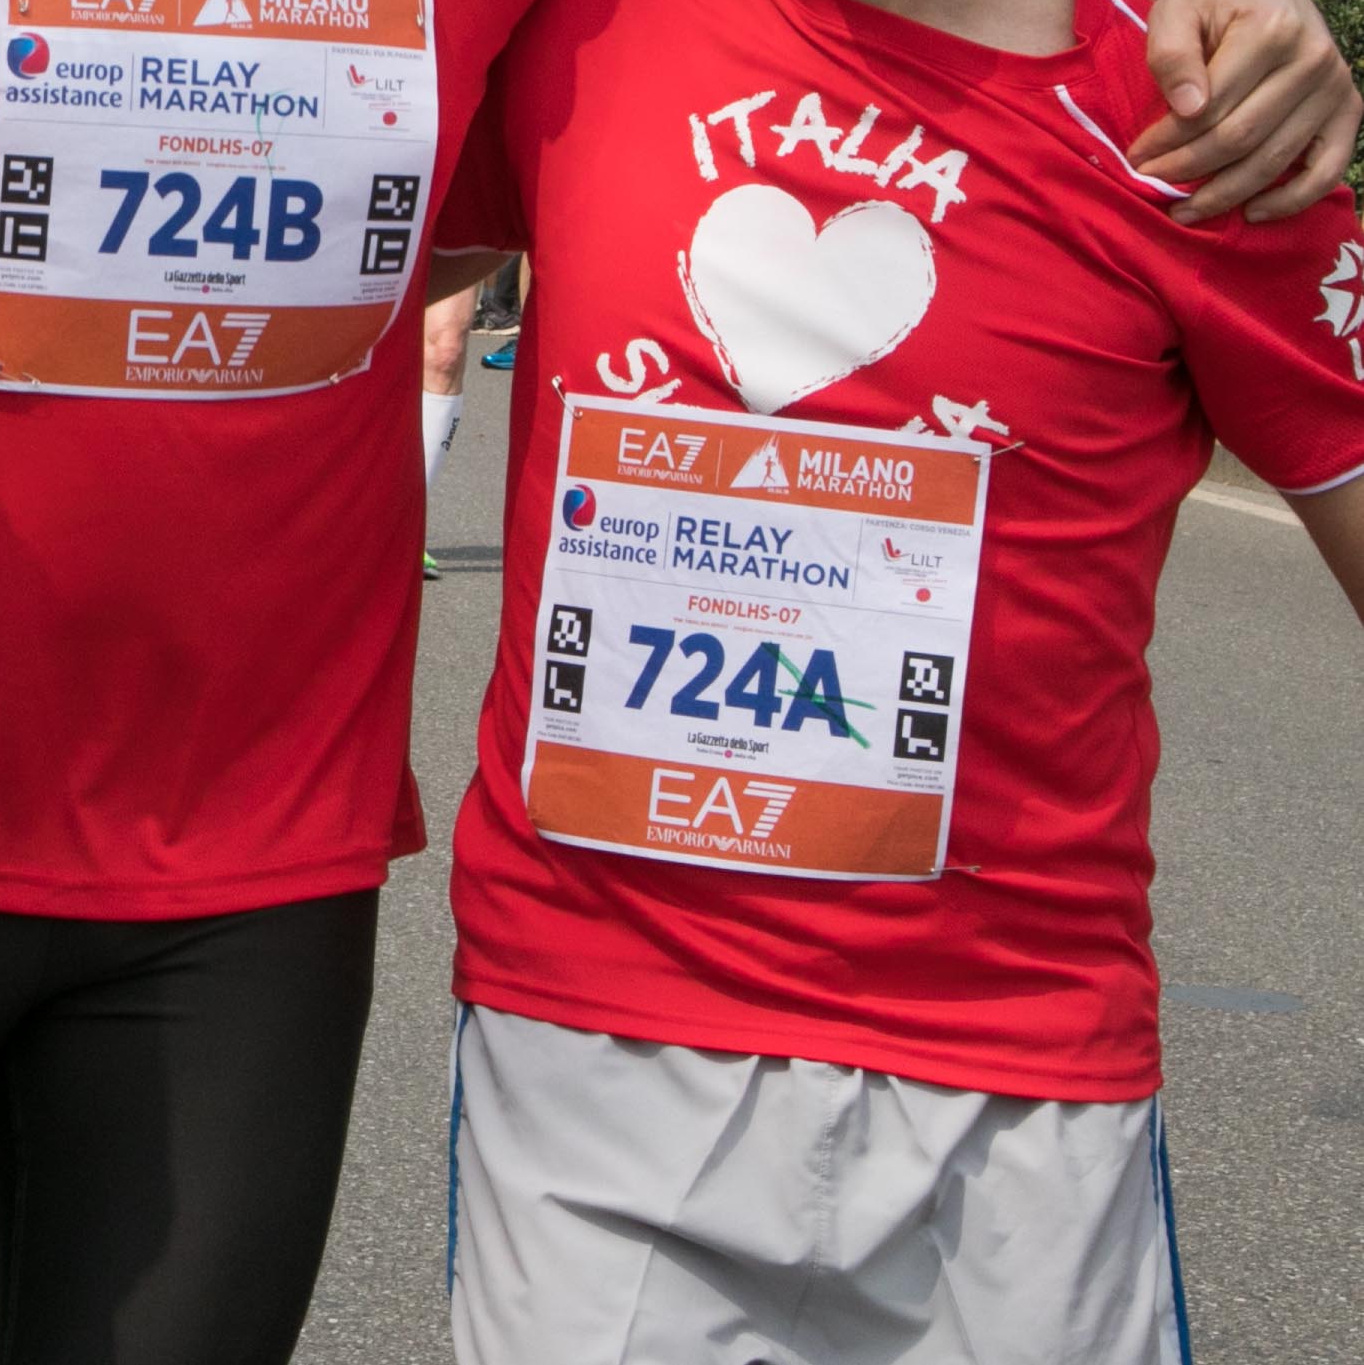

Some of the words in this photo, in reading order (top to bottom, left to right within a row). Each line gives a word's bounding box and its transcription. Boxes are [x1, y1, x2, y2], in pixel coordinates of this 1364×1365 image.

[125, 12, 164, 25] ARMANI
[259, 7, 369, 29] MARATHON
[56, 63, 123, 86] europ
[141, 57, 260, 88] RELAY
[375, 78, 404, 92] LILT
[5, 82, 122, 108] assistance
[140, 87, 318, 119] MARATHON
[159, 136, 273, 156] FONDLHS-07
[689, 90, 969, 223] ITALIA
[98, 170, 323, 262] 724B
[127, 309, 271, 366] EA7
[126, 366, 191, 383] EMPORIO
[213, 368, 263, 384] ARMANI
[617, 427, 706, 471] EA7
[669, 471, 703, 485] ARMANI
[798, 448, 914, 486] MILANO
[797, 473, 912, 501] MARATHON
[600, 515, 659, 540] europ
[675, 515, 793, 555] RELAY
[558, 535, 657, 565] assistance
[911, 553, 943, 568] LILT
[673, 547, 849, 589] MARATHON
[688, 595, 802, 624] FONDLHS-07
[624, 624, 851, 738] 724A
[648, 768, 797, 838] EA7
[646, 825, 713, 849] EMPORIO
[731, 837, 791, 859] ARMANI
